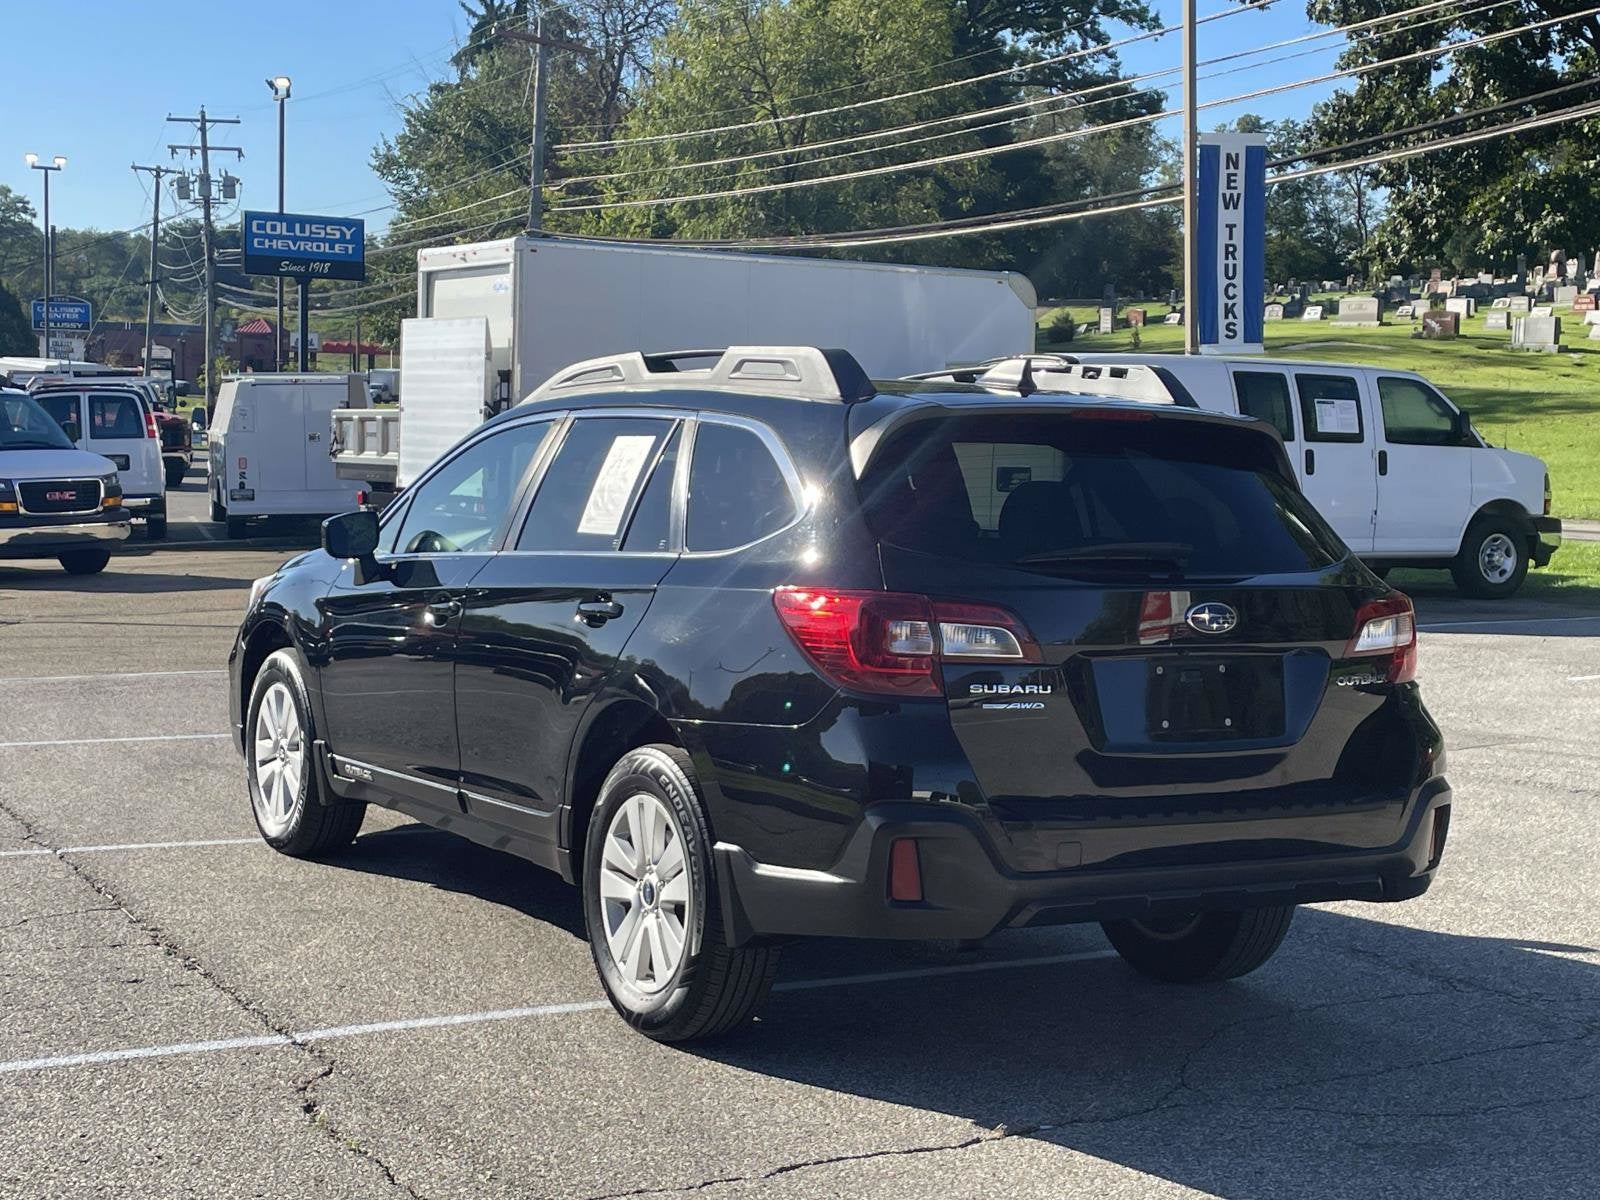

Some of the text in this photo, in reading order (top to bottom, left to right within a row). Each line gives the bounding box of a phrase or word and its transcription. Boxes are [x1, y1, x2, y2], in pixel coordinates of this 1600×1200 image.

[252, 219, 356, 240] COLUSSY
[253, 237, 356, 255] CHEVROLET
[1222, 152, 1241, 340] NEW TRUCKS
[279, 261, 331, 274] Since 1918
[46, 491, 77, 501] GMC
[969, 684, 1052, 694] SUBARU
